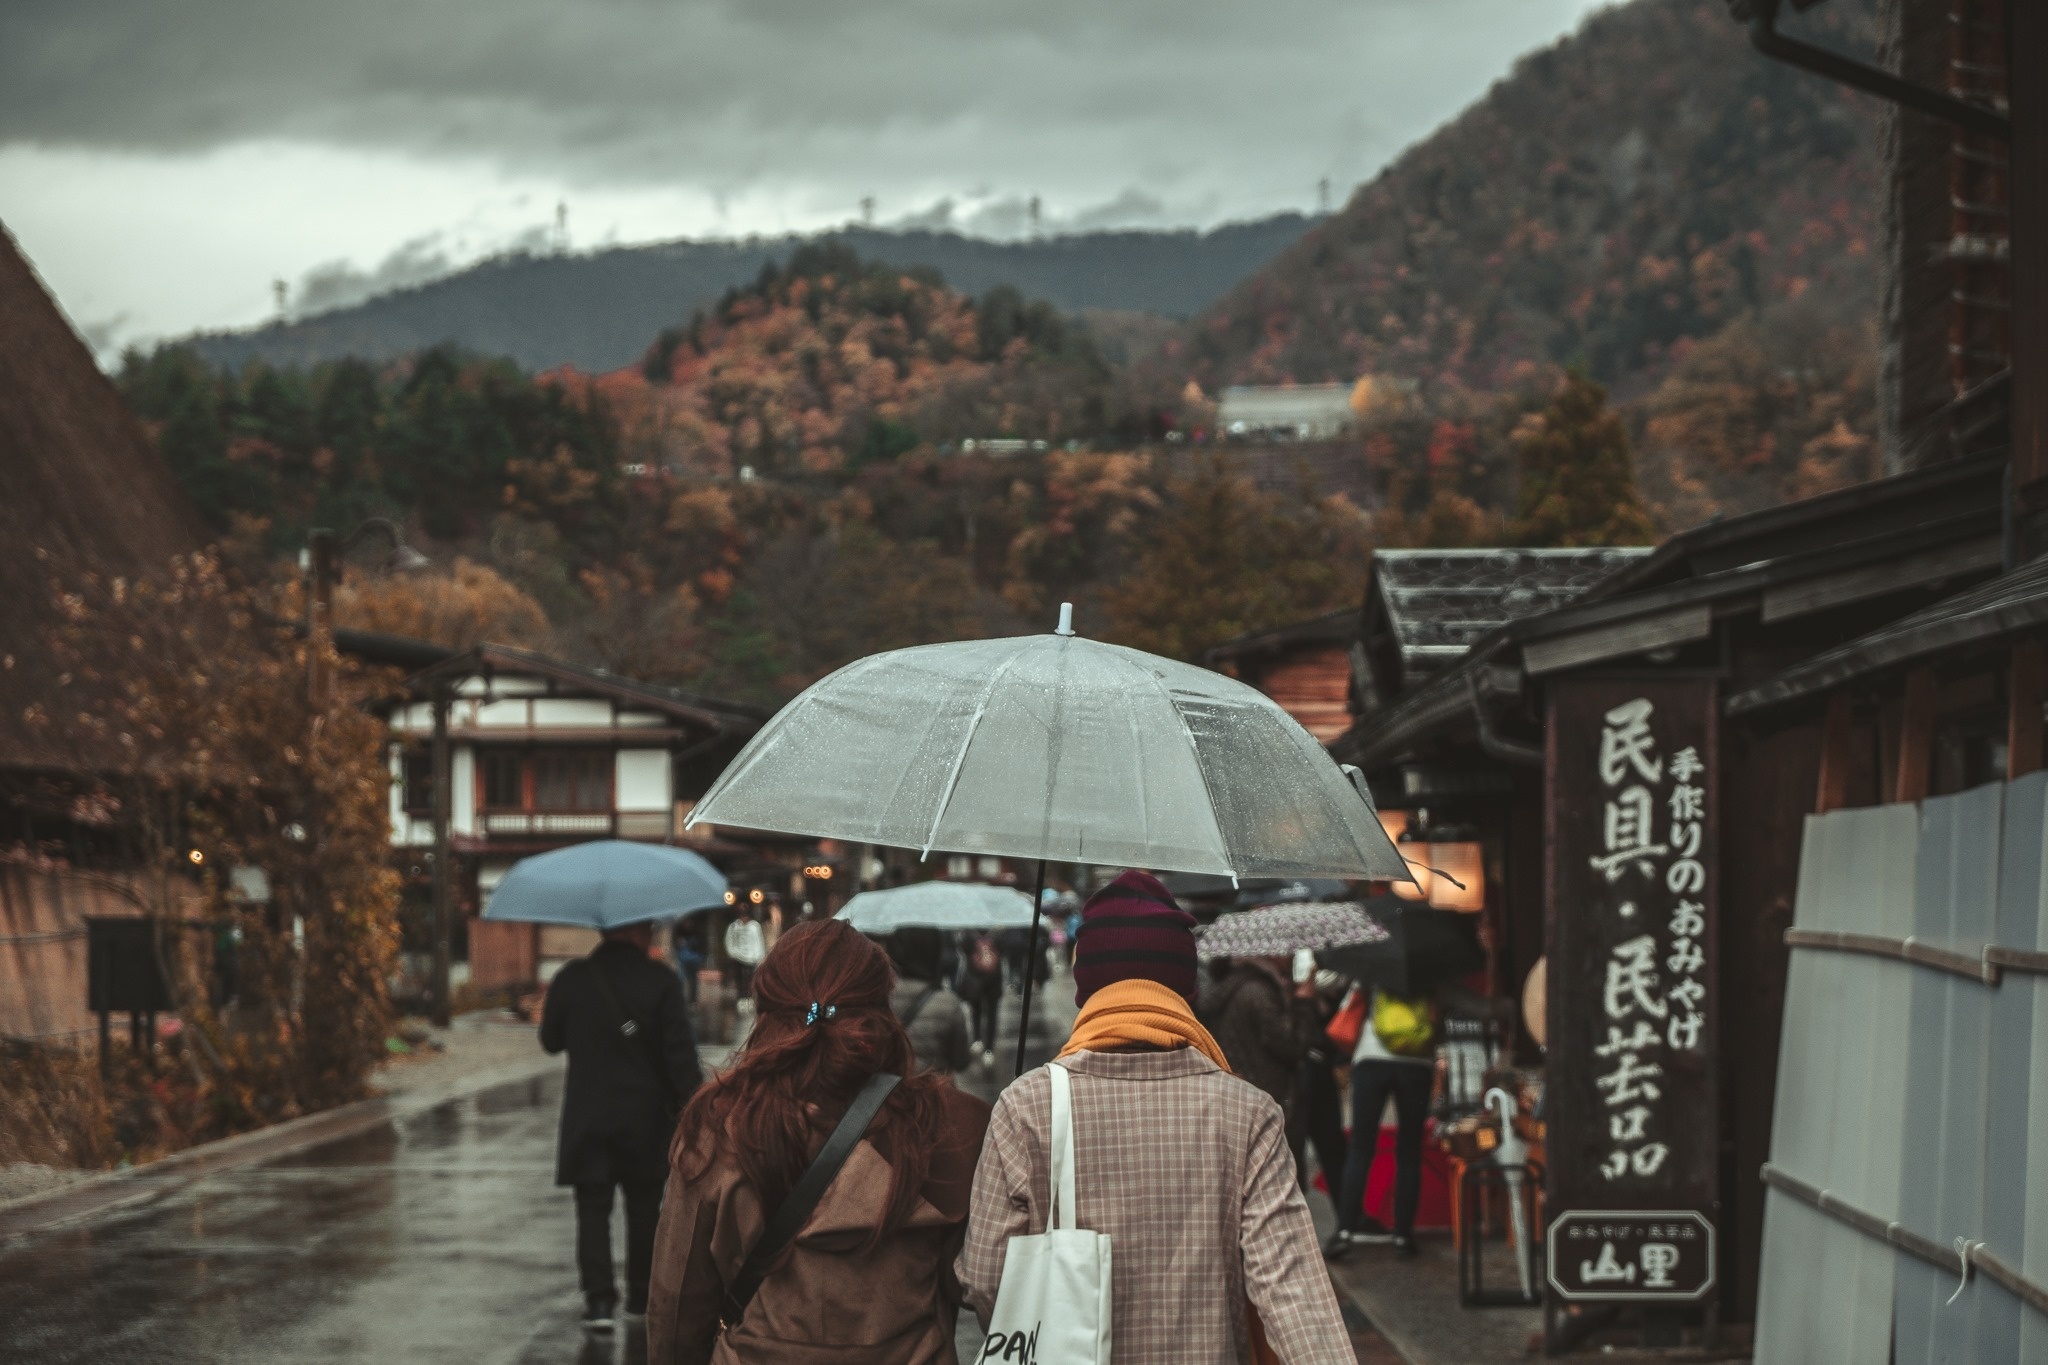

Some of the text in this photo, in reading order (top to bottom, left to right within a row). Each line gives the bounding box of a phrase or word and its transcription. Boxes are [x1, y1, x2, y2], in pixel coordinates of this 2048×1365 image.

[1667, 746, 1705, 1050] 手作りのおみやげ
[1580, 1241, 1680, 1287] 山里
[979, 1320, 1041, 1365] PAN
